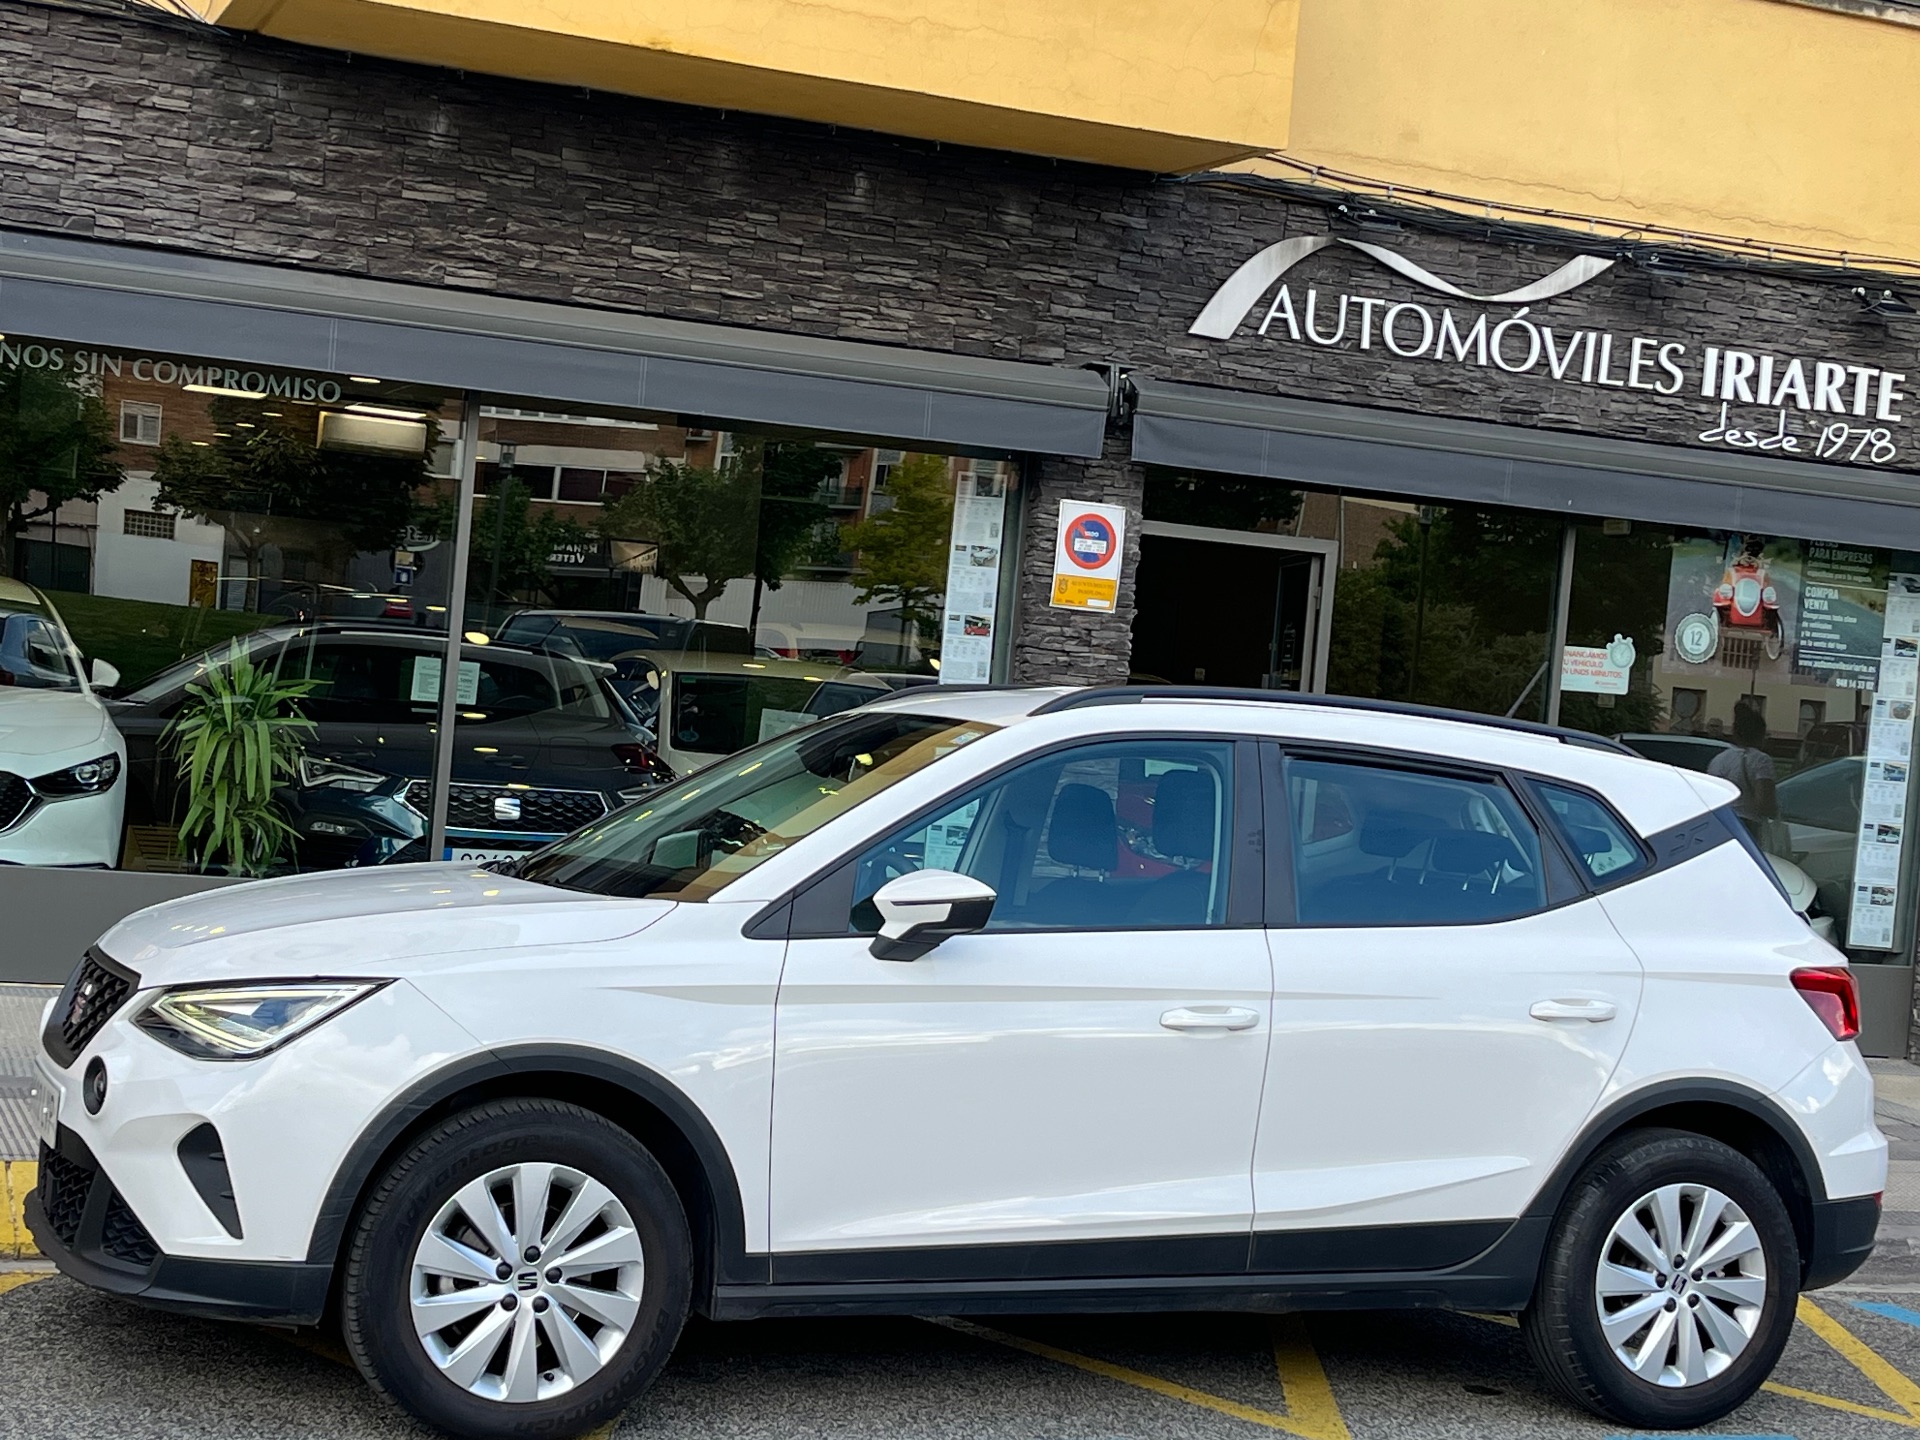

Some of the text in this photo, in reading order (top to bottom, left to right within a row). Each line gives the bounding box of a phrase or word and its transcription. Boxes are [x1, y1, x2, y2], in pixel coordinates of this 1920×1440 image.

[1257, 283, 1906, 423] AUTOMÓVILES IRIARTE
[73, 349, 123, 377] SIN
[132, 358, 343, 404] COMPROMISO
[1698, 401, 1896, 463] desde 1978
[1808, 547, 1874, 565] PARA EMPRESAS
[1804, 585, 1839, 600] COMPRA
[1803, 598, 1829, 611] VENTA
[1690, 629, 1703, 647] 12
